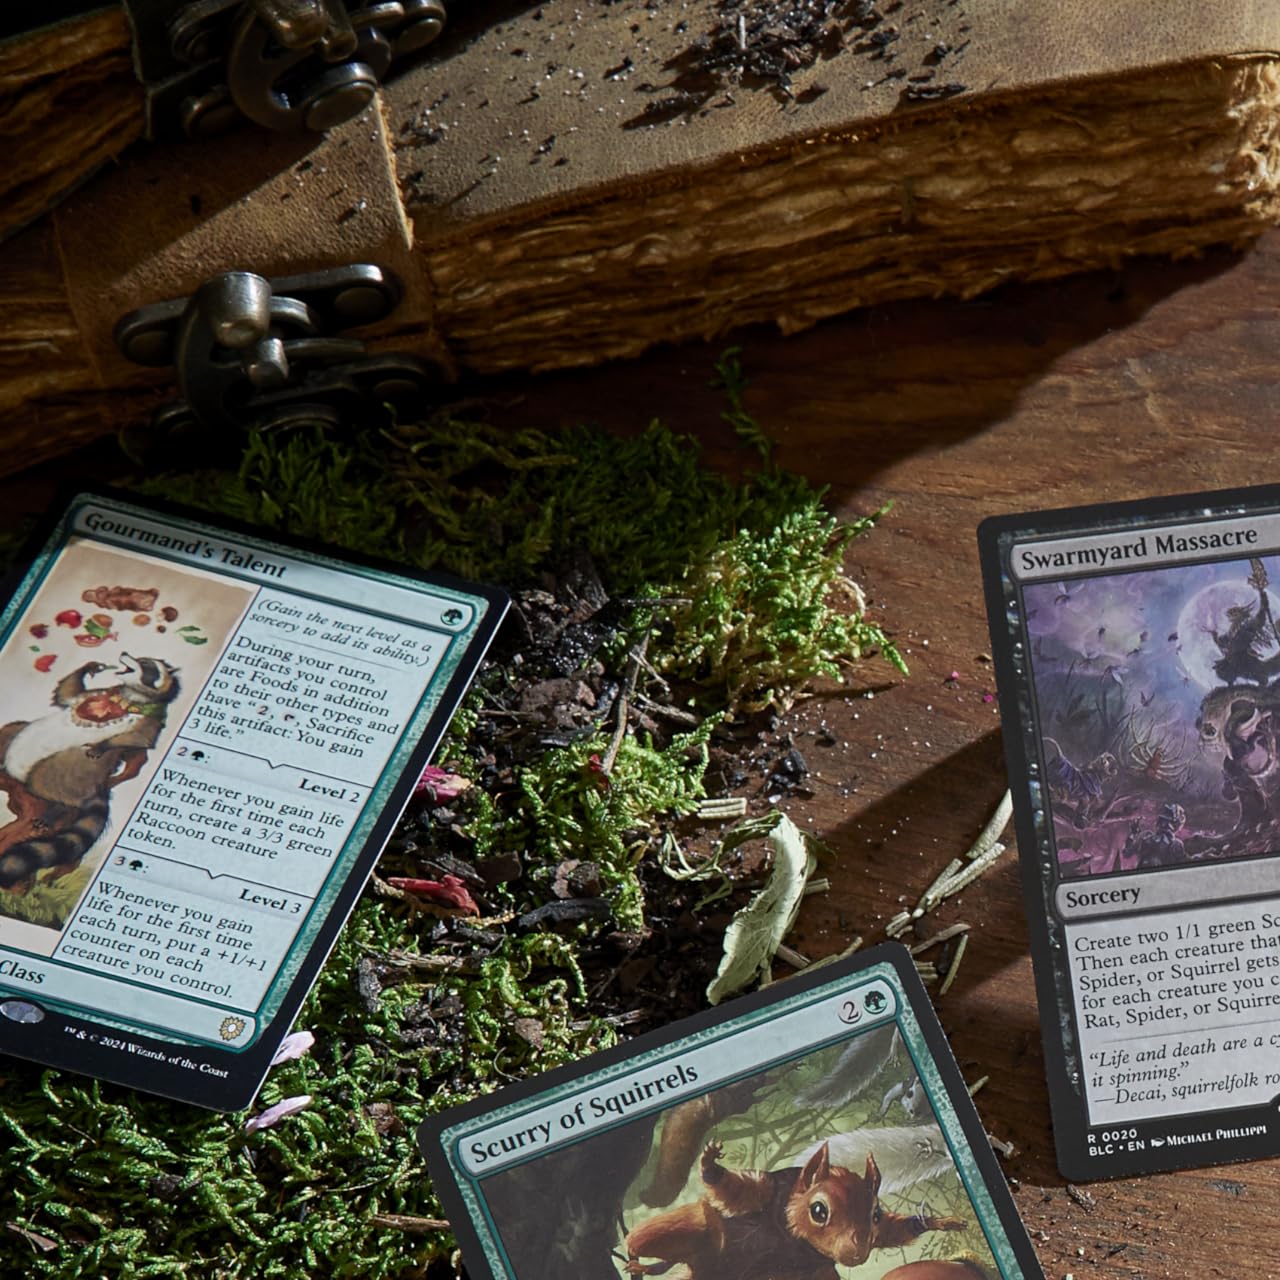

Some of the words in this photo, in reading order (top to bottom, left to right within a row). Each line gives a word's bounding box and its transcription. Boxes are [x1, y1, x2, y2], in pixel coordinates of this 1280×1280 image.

[84, 512, 215, 559] Gourmand's
[220, 547, 287, 579] Talent
[1021, 536, 1147, 570] Swarmyard
[1155, 529, 1257, 554] Massacre
[234, 635, 293, 662] During
[294, 654, 334, 671] your
[337, 665, 375, 684] turn,
[163, 767, 242, 800] Whenever
[242, 794, 275, 810] you
[277, 804, 314, 820] gain
[317, 811, 344, 828] life
[298, 777, 347, 799] Level
[348, 791, 360, 803] 2
[238, 888, 288, 910] Level
[289, 902, 302, 913] 3
[1066, 887, 1141, 908] Sorcery
[69, 929, 136, 953] counter
[138, 948, 160, 961] on
[165, 955, 203, 973] each
[1074, 935, 1132, 952] Create
[1137, 931, 1169, 945] two
[1176, 923, 1200, 940] 1/1
[1208, 920, 1256, 939] green
[1083, 1013, 1120, 1029] Rat,
[1125, 1004, 1188, 1026] Spider,
[1192, 1002, 1211, 1015] or
[470, 1120, 551, 1163] Scurry
[559, 1101, 585, 1129] of
[589, 1064, 698, 1118] Squirrels
[1087, 1134, 1096, 1144] R
[1101, 1128, 1137, 1142] 0020
[1088, 1143, 1114, 1156] BLC
[1127, 1140, 1145, 1151] EN
[1166, 1131, 1213, 1146] MICHAEL
[1215, 1124, 1267, 1140] PHILLIPPI
